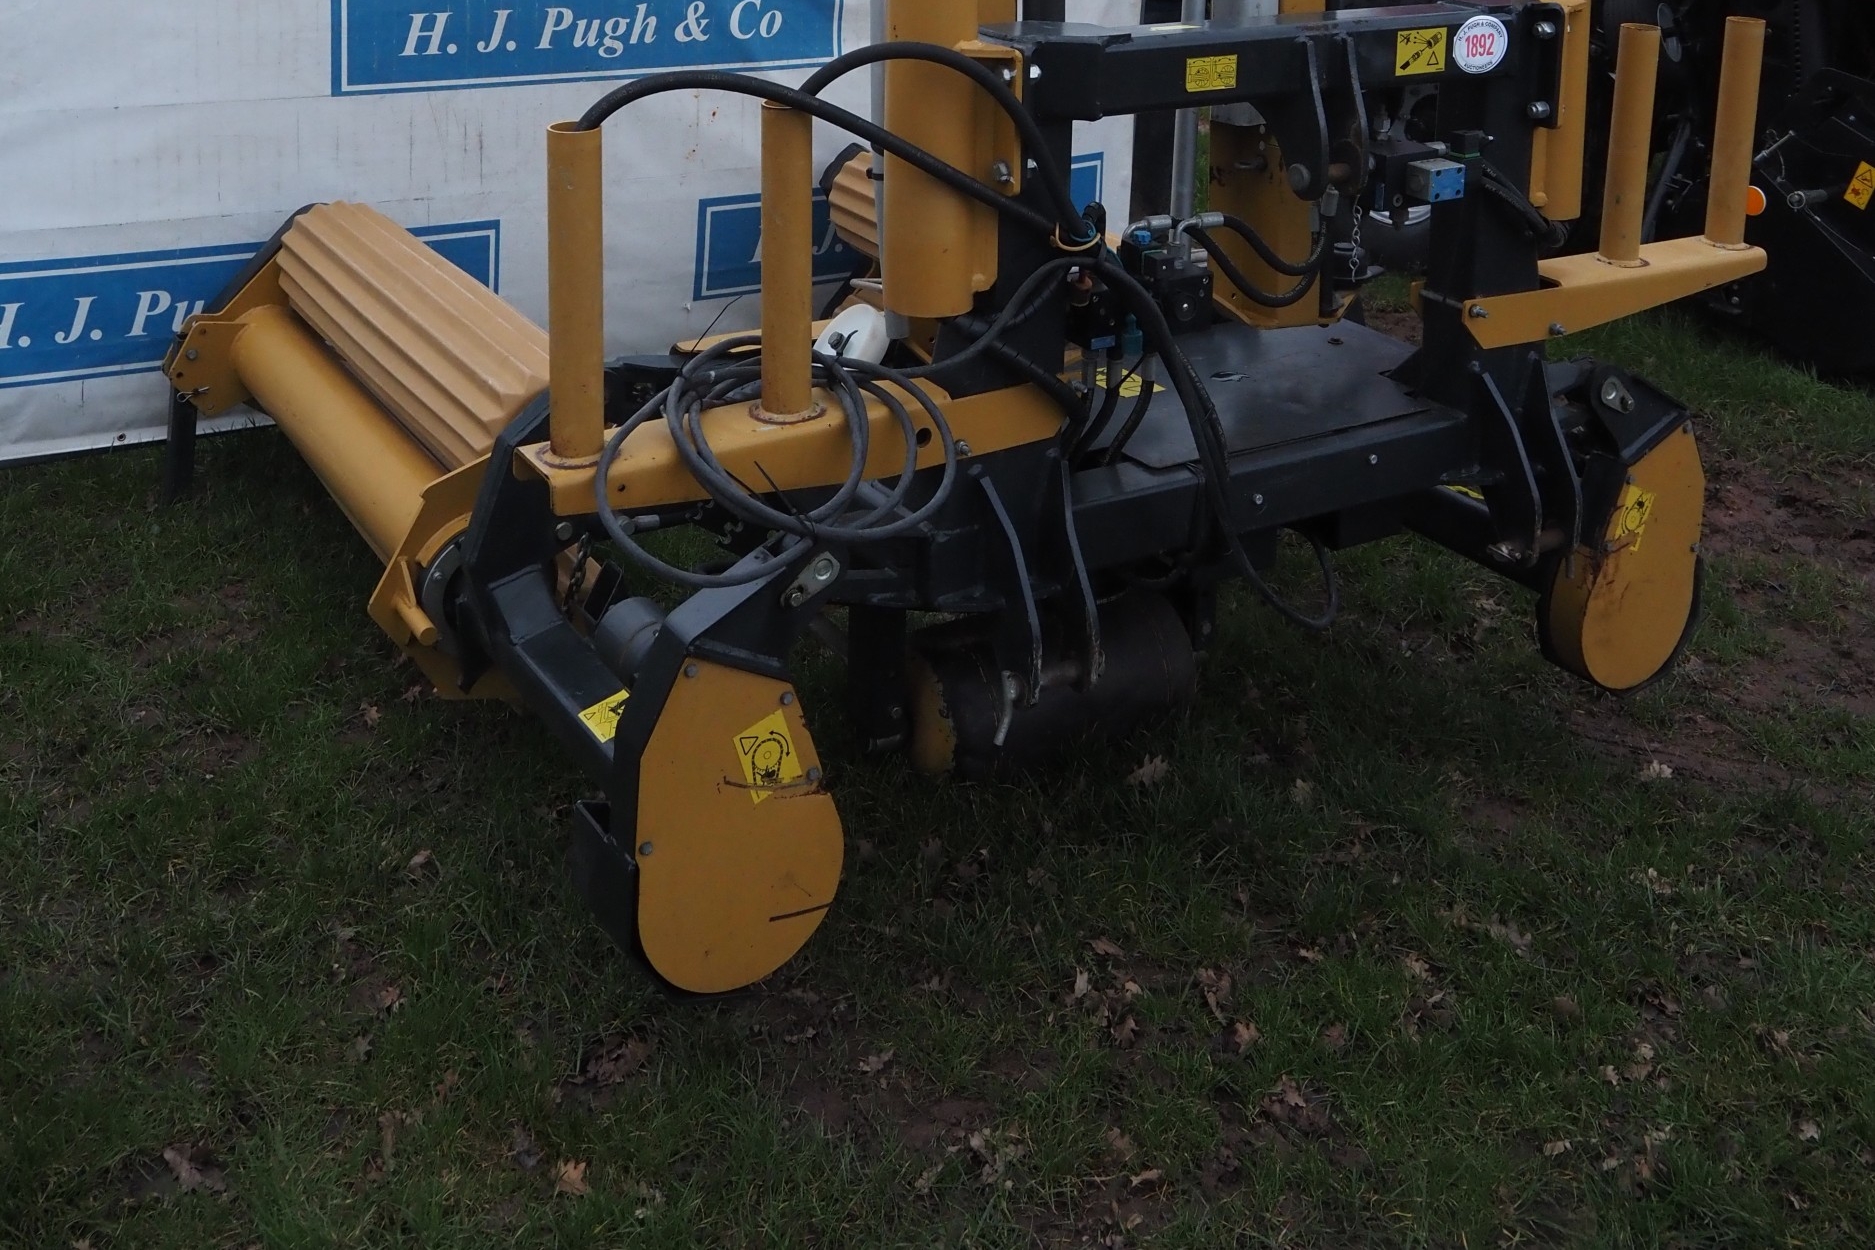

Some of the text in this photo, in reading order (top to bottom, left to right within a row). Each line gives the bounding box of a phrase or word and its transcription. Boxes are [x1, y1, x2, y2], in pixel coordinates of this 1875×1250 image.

[399, 12, 458, 56] H.
[476, 9, 517, 53] J.
[535, 2, 657, 58] Pugh
[674, 0, 710, 43] &
[1465, 32, 1495, 58] 1892
[54, 296, 103, 344] J.
[125, 290, 205, 337] Pu
